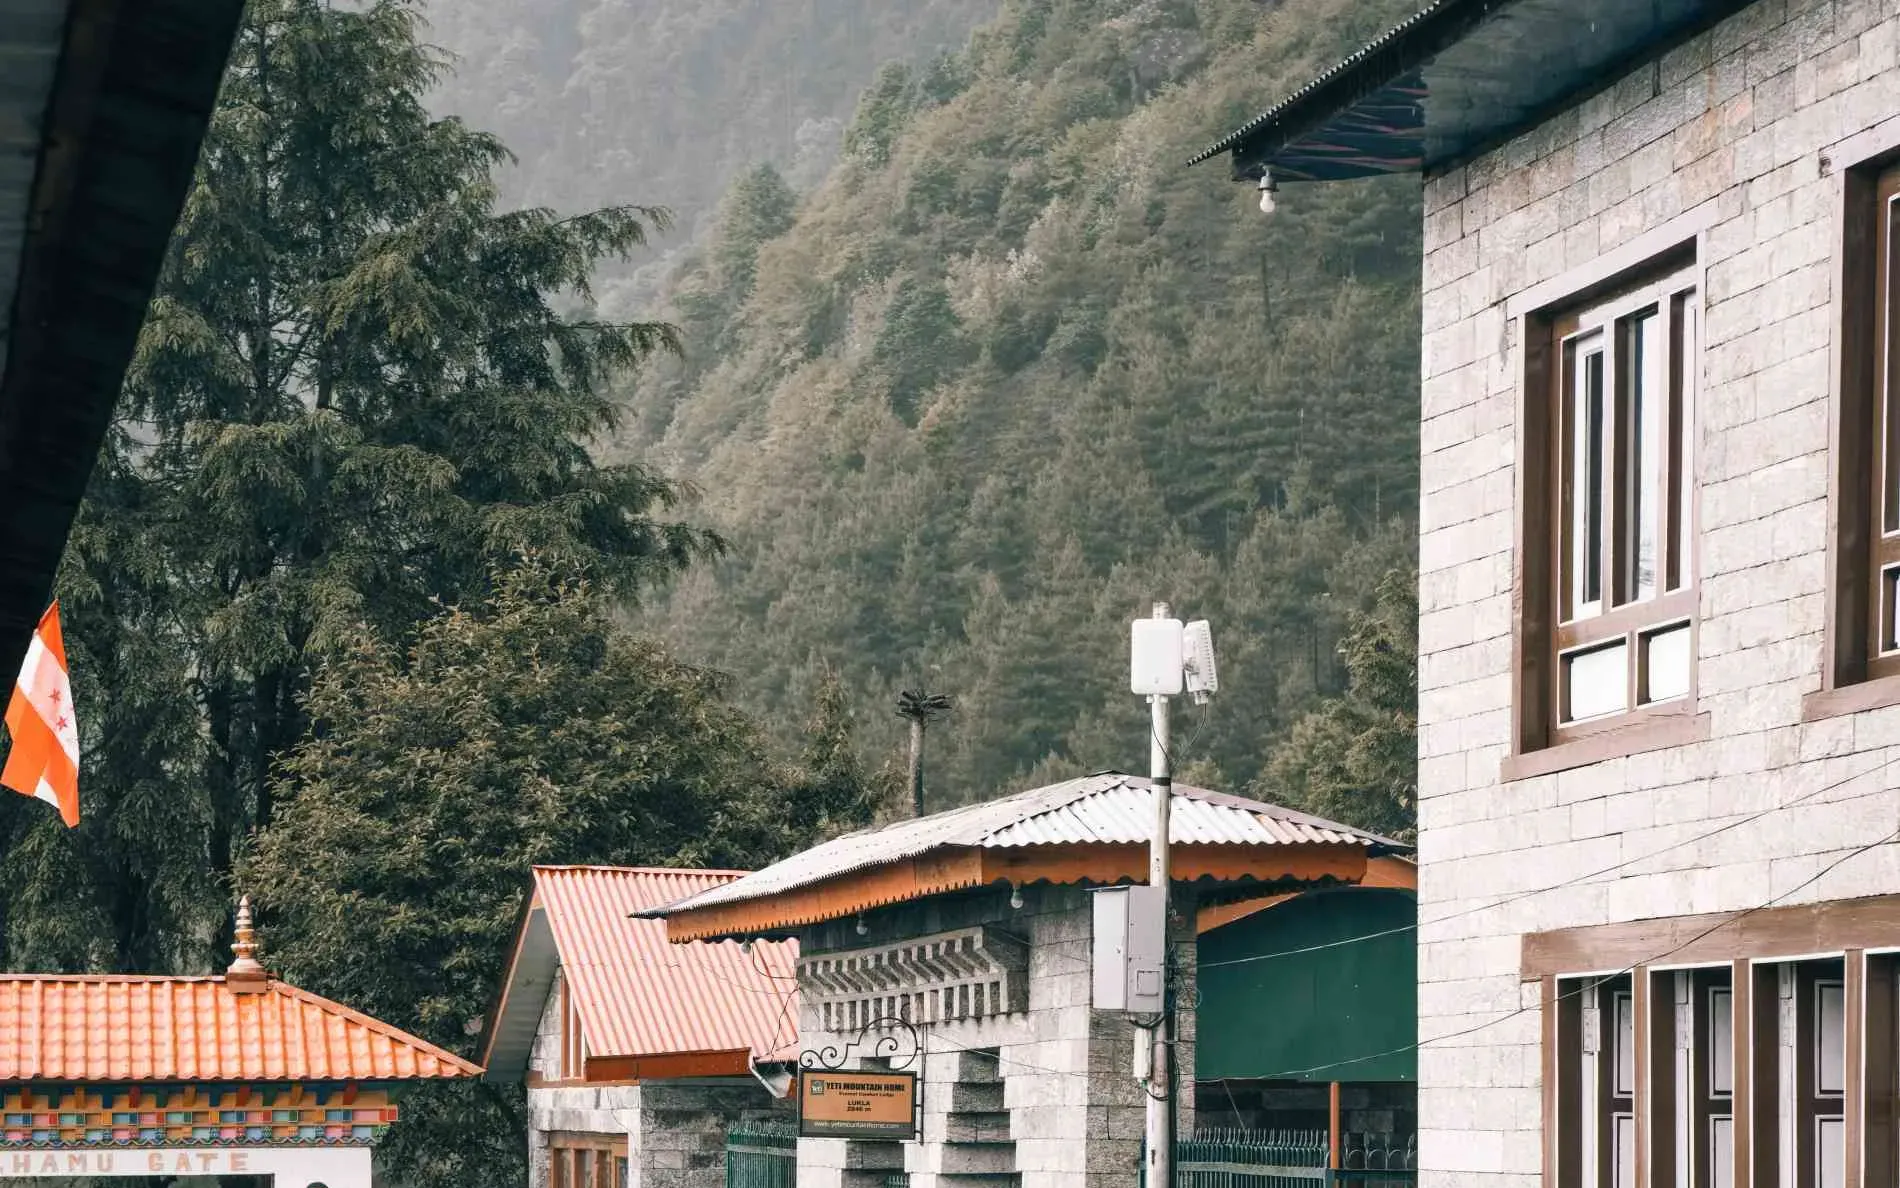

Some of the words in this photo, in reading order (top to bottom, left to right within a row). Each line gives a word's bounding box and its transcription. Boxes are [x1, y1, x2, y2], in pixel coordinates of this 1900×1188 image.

[827, 1082, 842, 1090] YETI
[843, 1082, 882, 1091] MOUNTAIN
[0, 1152, 114, 1174] HAMU
[147, 1152, 249, 1172] GATE
